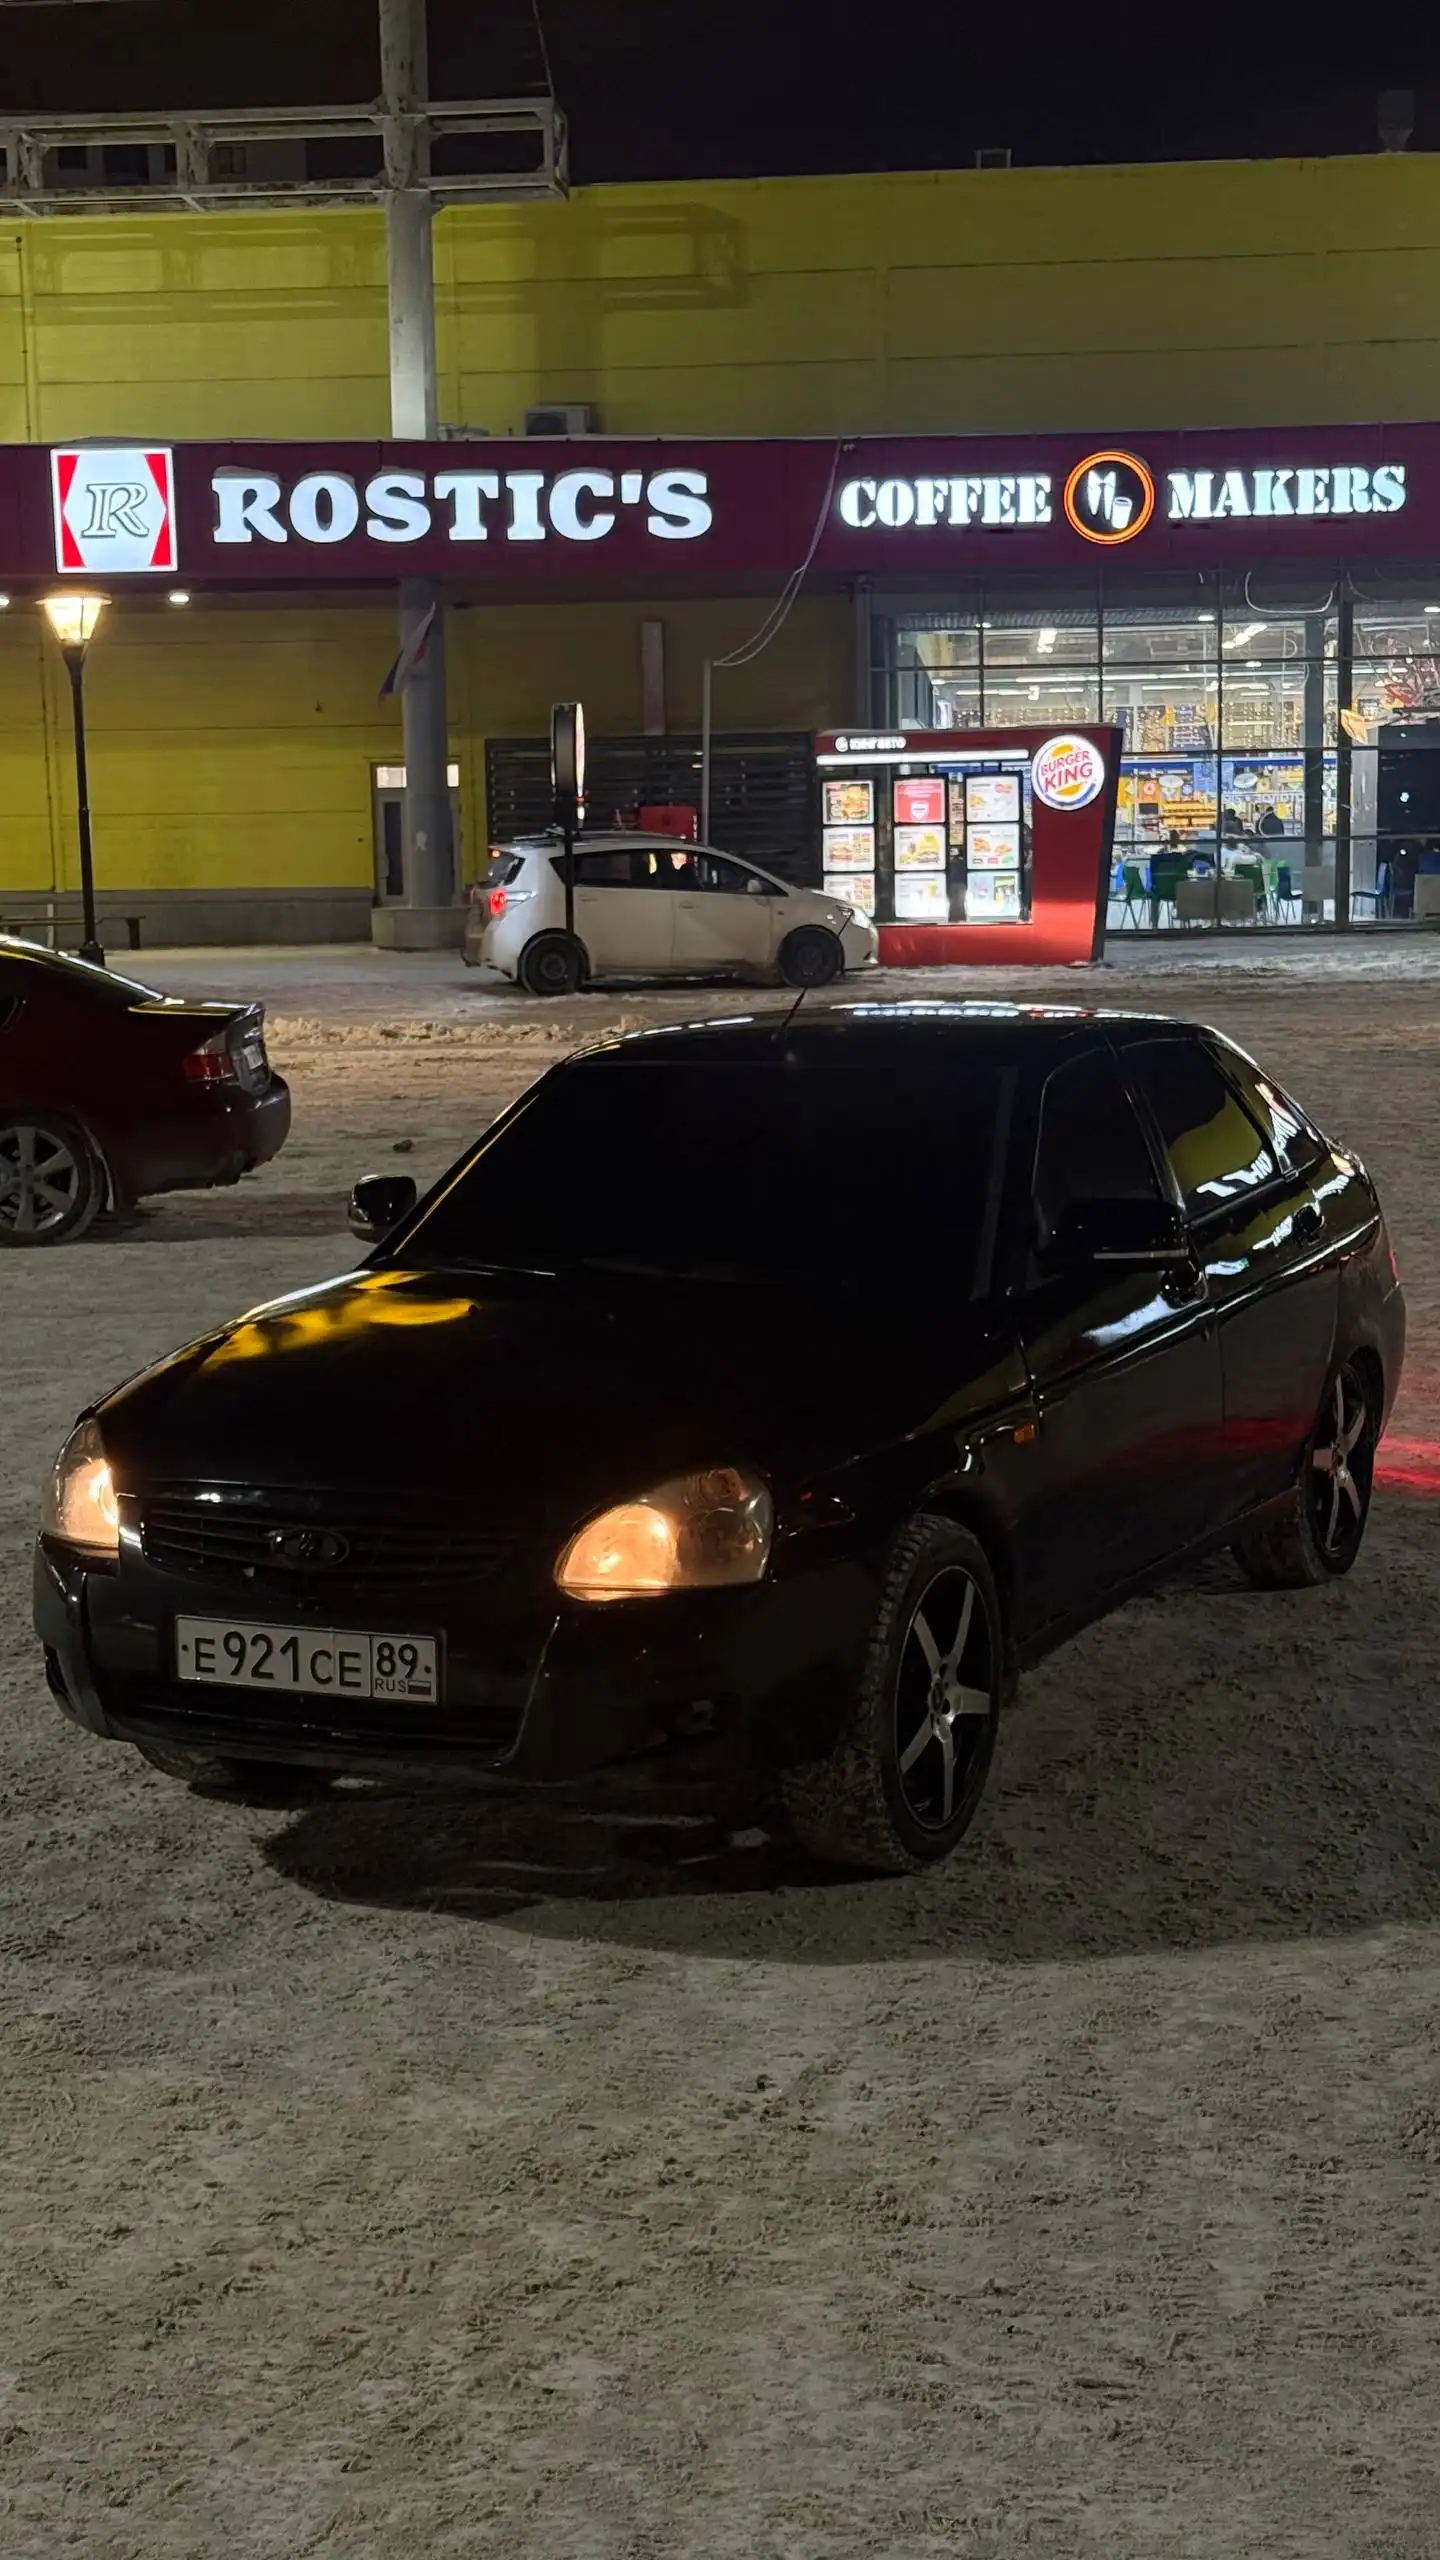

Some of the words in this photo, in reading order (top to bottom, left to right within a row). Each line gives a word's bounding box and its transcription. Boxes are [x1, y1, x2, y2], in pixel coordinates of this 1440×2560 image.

[211, 472, 713, 543] ROSTIC'S
[839, 475, 1052, 528] COFFEE
[1167, 466, 1407, 519] MAKERS
[1041, 750, 1090, 776] BURGER
[1045, 762, 1093, 792] KING
[375, 1641, 419, 1680] 89
[374, 1677, 407, 1694] RUS
